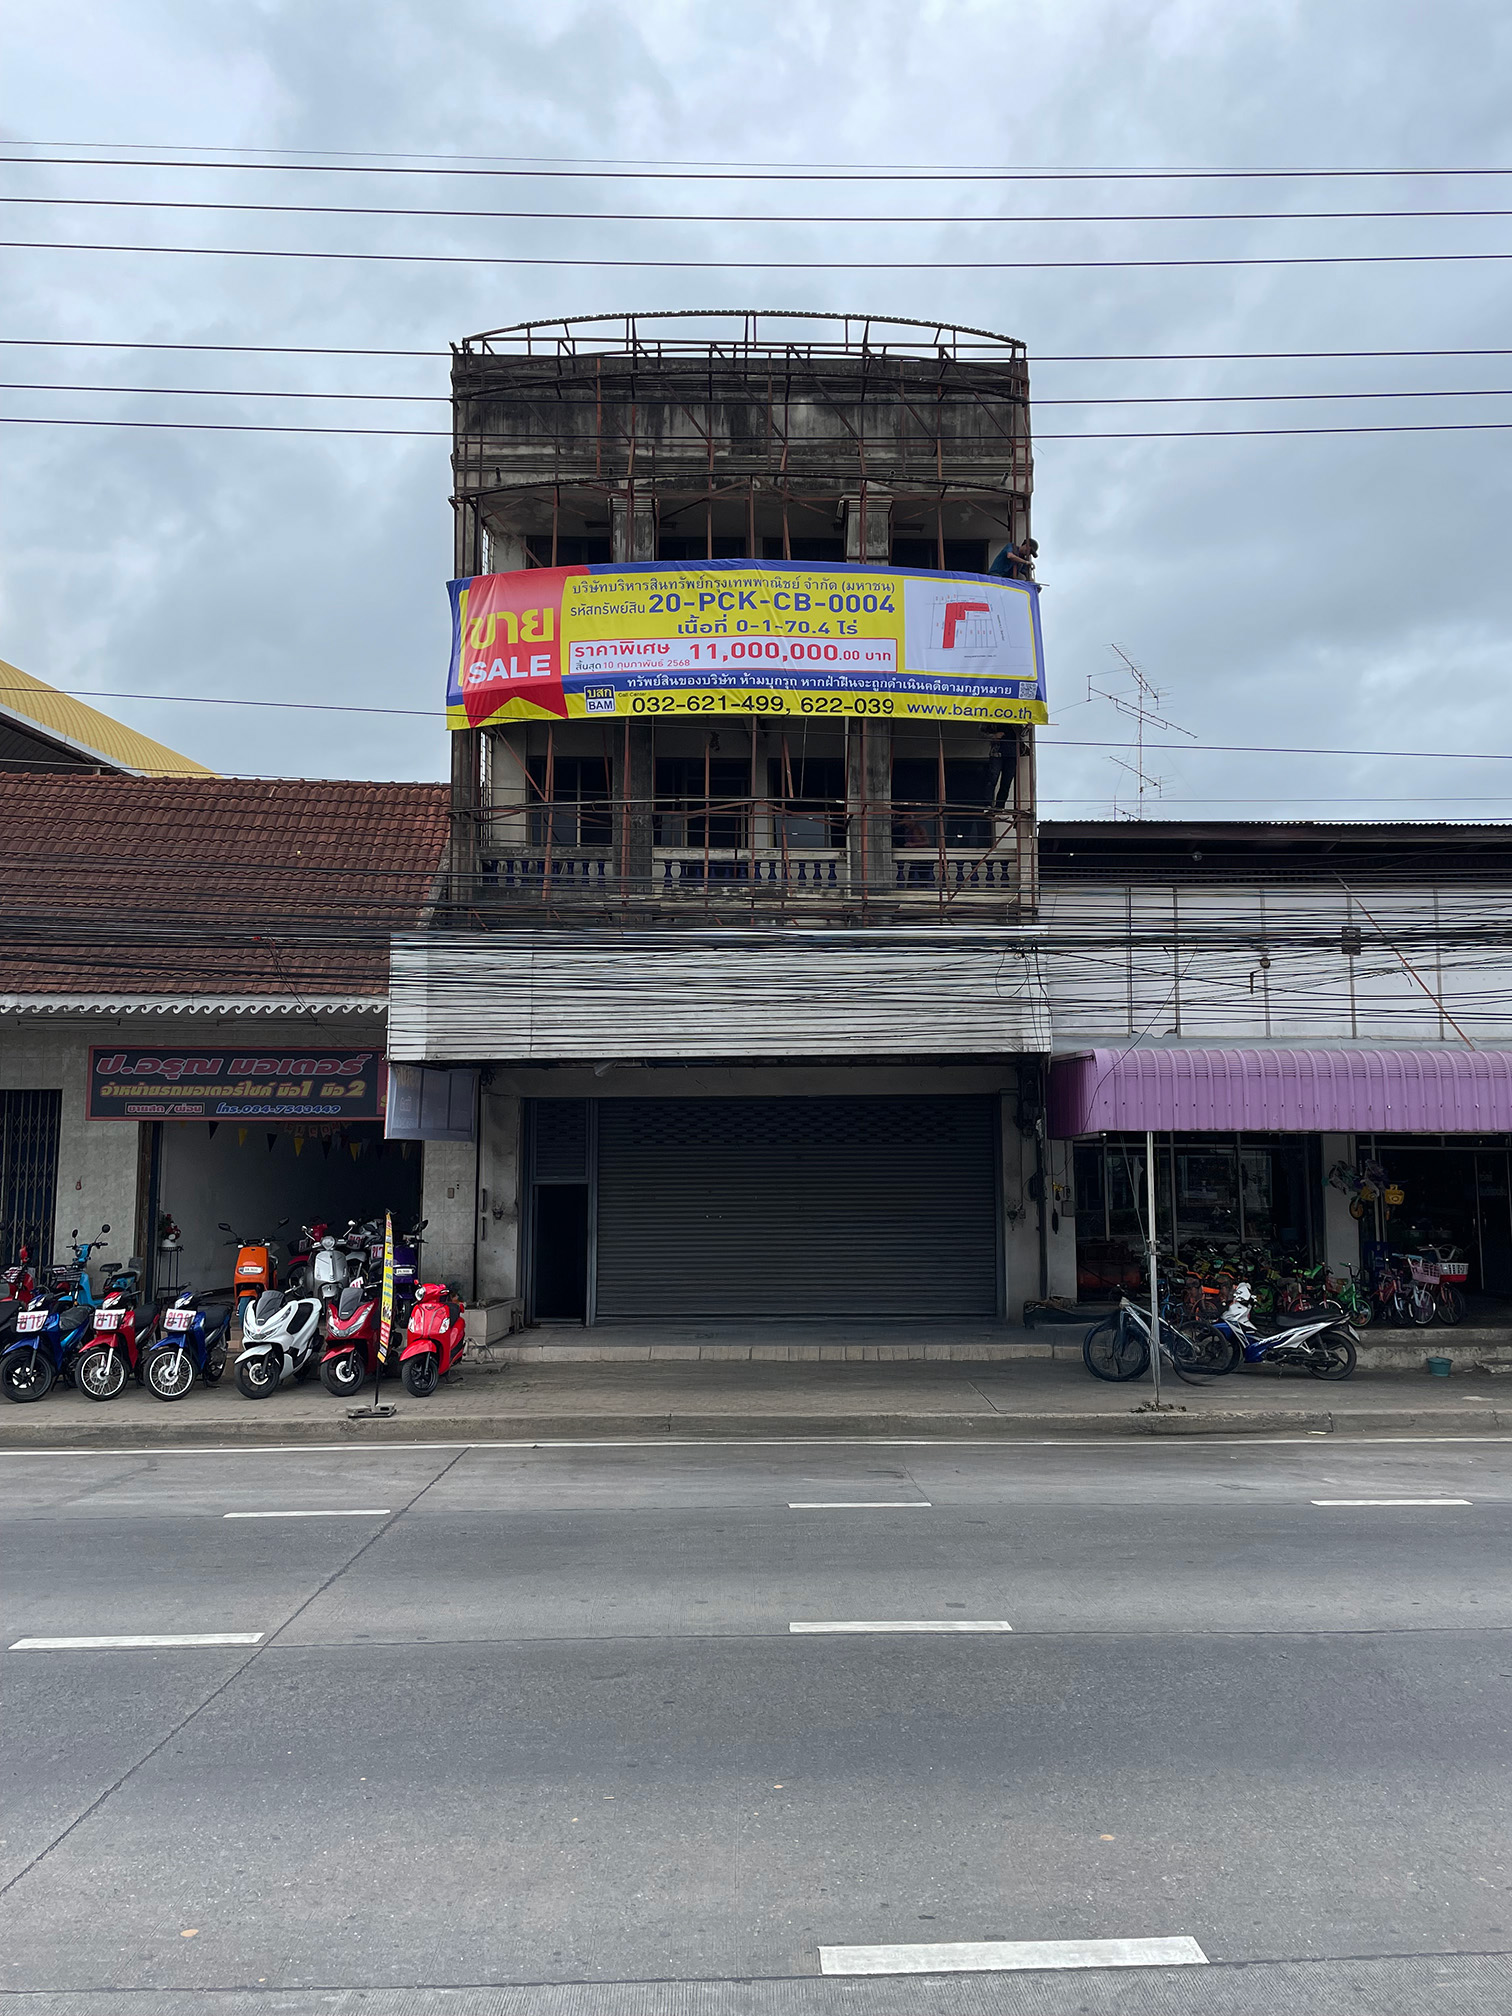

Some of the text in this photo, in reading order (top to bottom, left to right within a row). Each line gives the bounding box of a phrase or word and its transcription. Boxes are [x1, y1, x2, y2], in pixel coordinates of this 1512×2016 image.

[572, 575, 895, 594] บริษัทบริหารสินทรัพย์กรุงเทพพาณิชย์ จำกัด (มหาชน)
[570, 591, 895, 617] รหัสทรัพย์สิน 20-PCK-CB-0004
[470, 608, 554, 650] ขาย
[677, 613, 858, 635] เนื้อที่ 0-1-70.4 ไร่
[574, 641, 891, 662] ราคาพิเศษ 11,000,000.00 บาท
[468, 654, 551, 684] SALE
[575, 658, 690, 672] สิ้นสุด 10 กุมภาพันธ์ 2568
[627, 673, 736, 688] ทรัพย์สินของบริษัท
[740, 672, 797, 690] ห้ามบุกรุก
[586, 688, 612, 698] บสก
[588, 700, 613, 711] BAM
[632, 695, 1033, 719] 032-621-499, 622-039 www.bam.co.th
[96, 1053, 373, 1080] ป.อรุณ มอเตอร์
